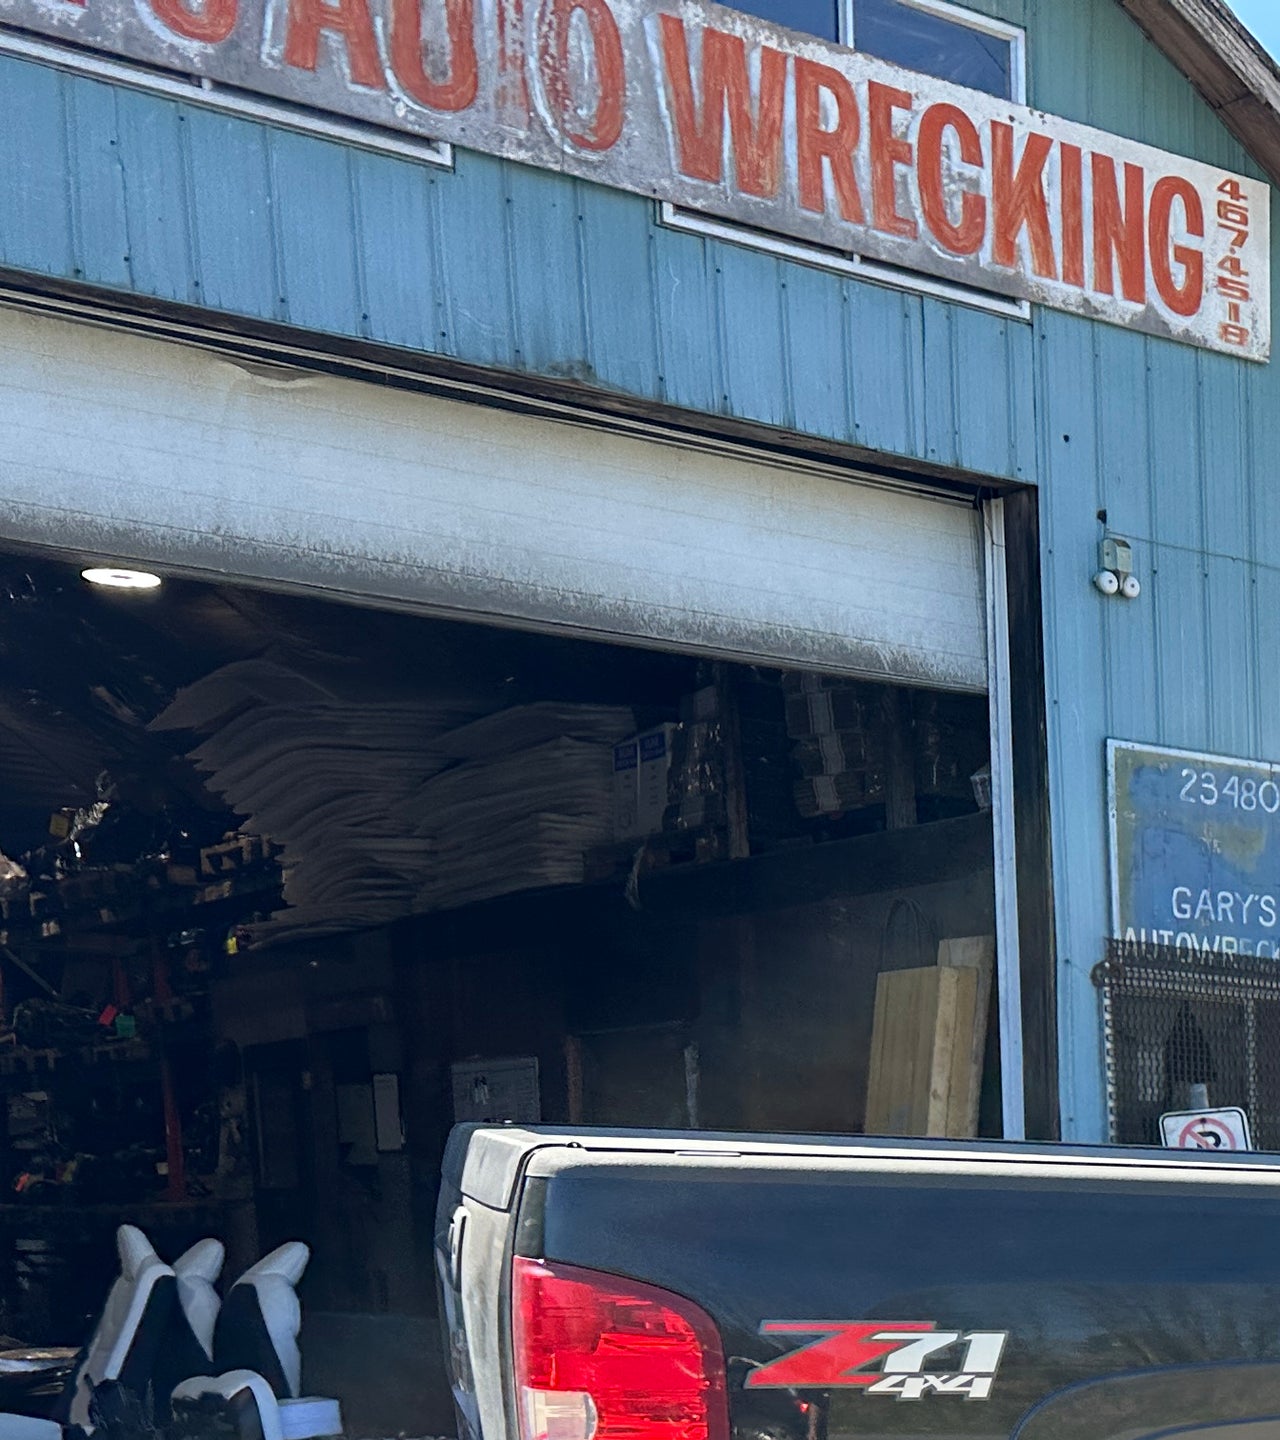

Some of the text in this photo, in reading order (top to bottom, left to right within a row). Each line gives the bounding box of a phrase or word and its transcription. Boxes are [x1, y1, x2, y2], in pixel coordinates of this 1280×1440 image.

[650, 12, 1205, 318] WRECKING
[1179, 767, 1280, 814] 23480
[1171, 886, 1277, 928] GARY'S
[746, 1319, 1008, 1388] Z71
